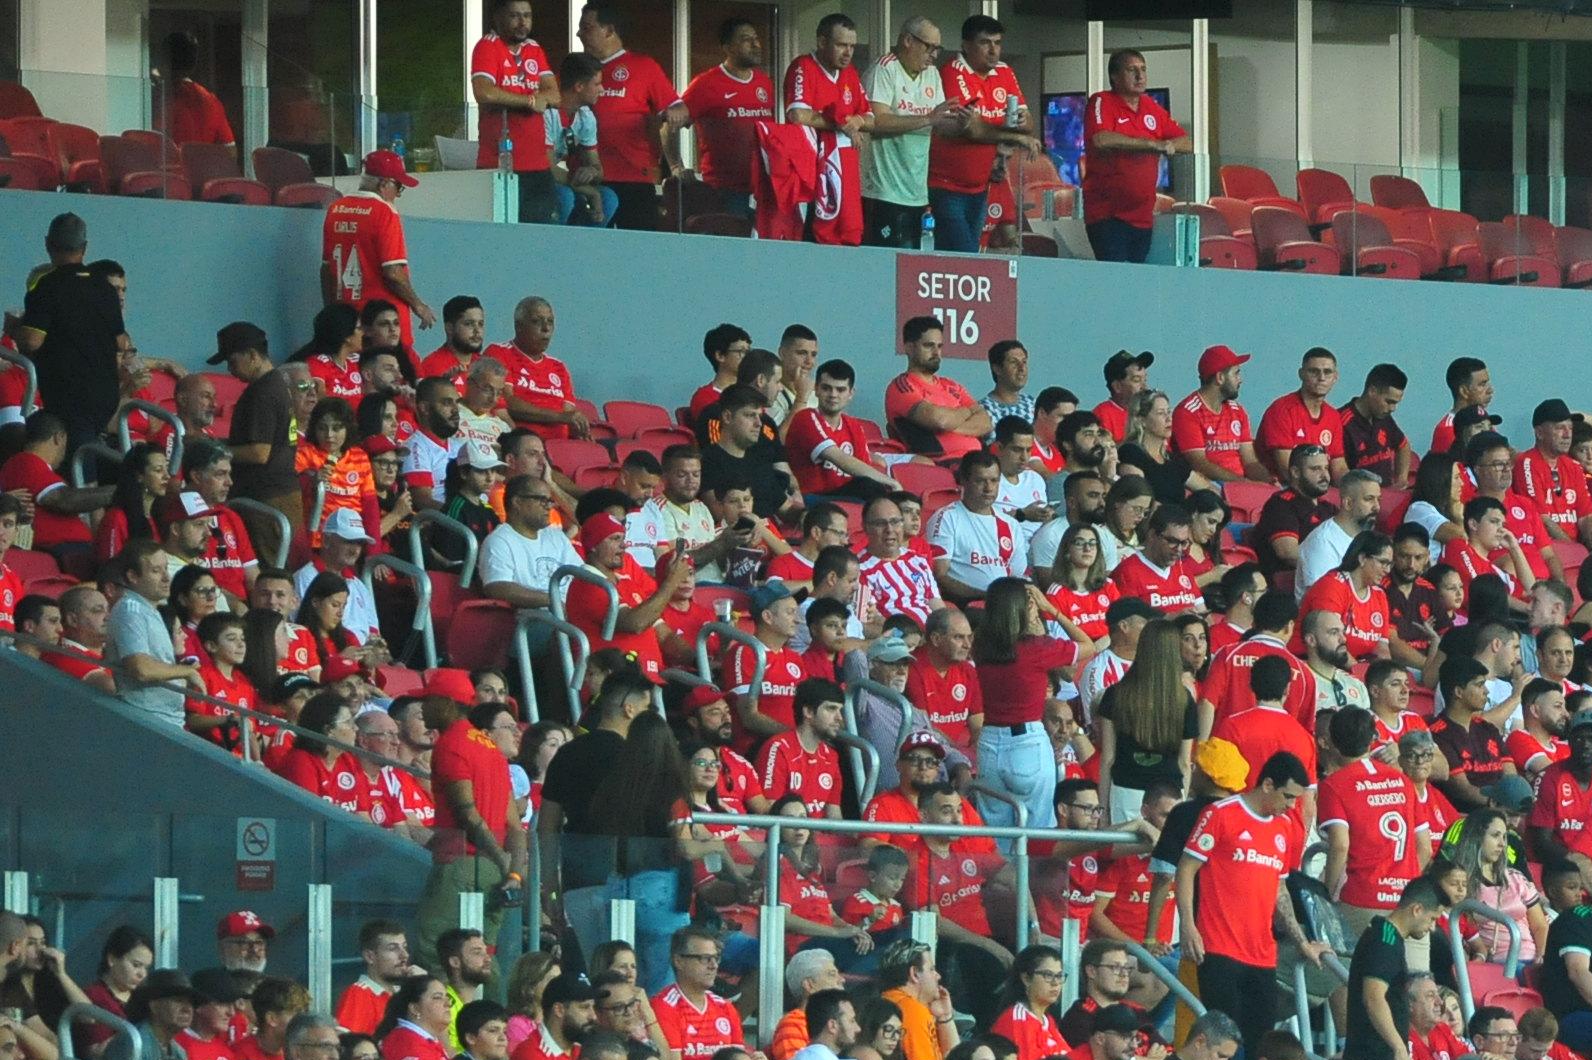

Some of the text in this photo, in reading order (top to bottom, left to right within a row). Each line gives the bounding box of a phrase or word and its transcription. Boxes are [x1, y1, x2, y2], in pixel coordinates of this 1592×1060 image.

[333, 243, 363, 300] 14
[919, 272, 992, 303] SETOR
[934, 708, 969, 723] Banrisul
[1364, 778, 1404, 791] Banrisul
[1379, 810, 1409, 862] 9
